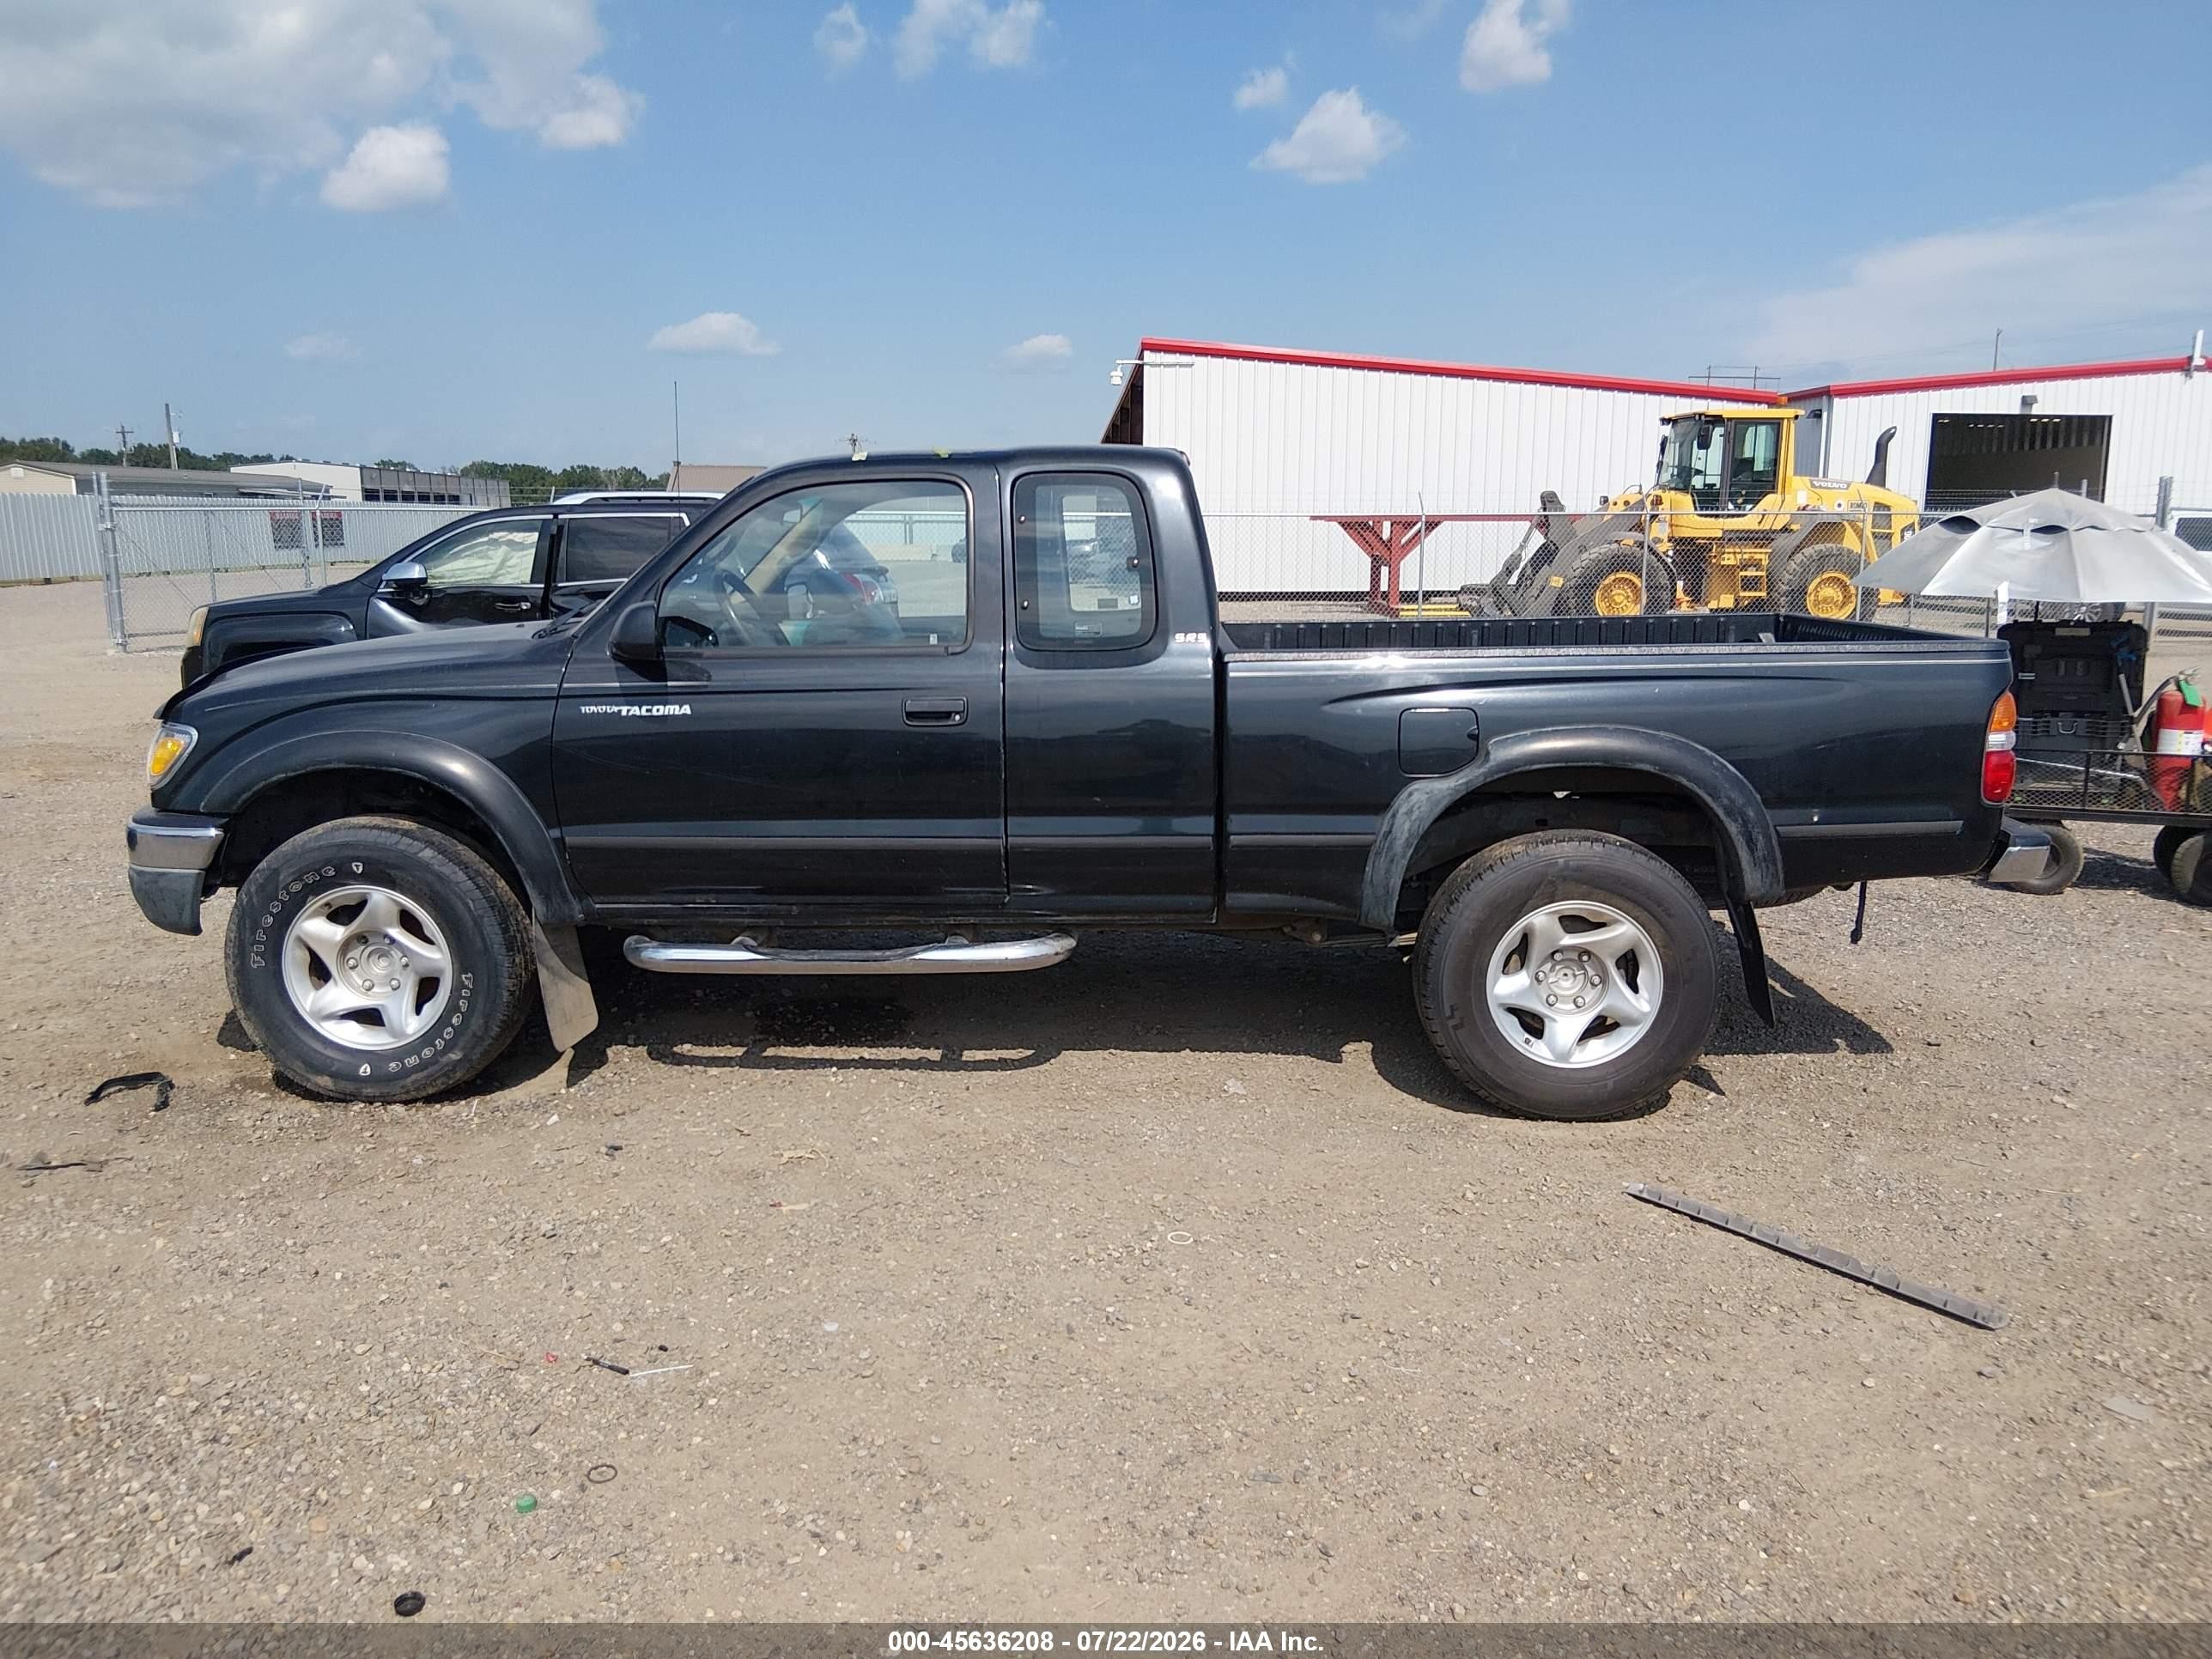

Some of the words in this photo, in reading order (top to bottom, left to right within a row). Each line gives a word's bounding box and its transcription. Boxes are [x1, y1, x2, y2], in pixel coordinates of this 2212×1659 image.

[580, 705, 619, 714] TOYOTA
[617, 704, 692, 716] TACOMA
[251, 865, 337, 969] Firestone
[388, 972, 474, 1073] Firestone
